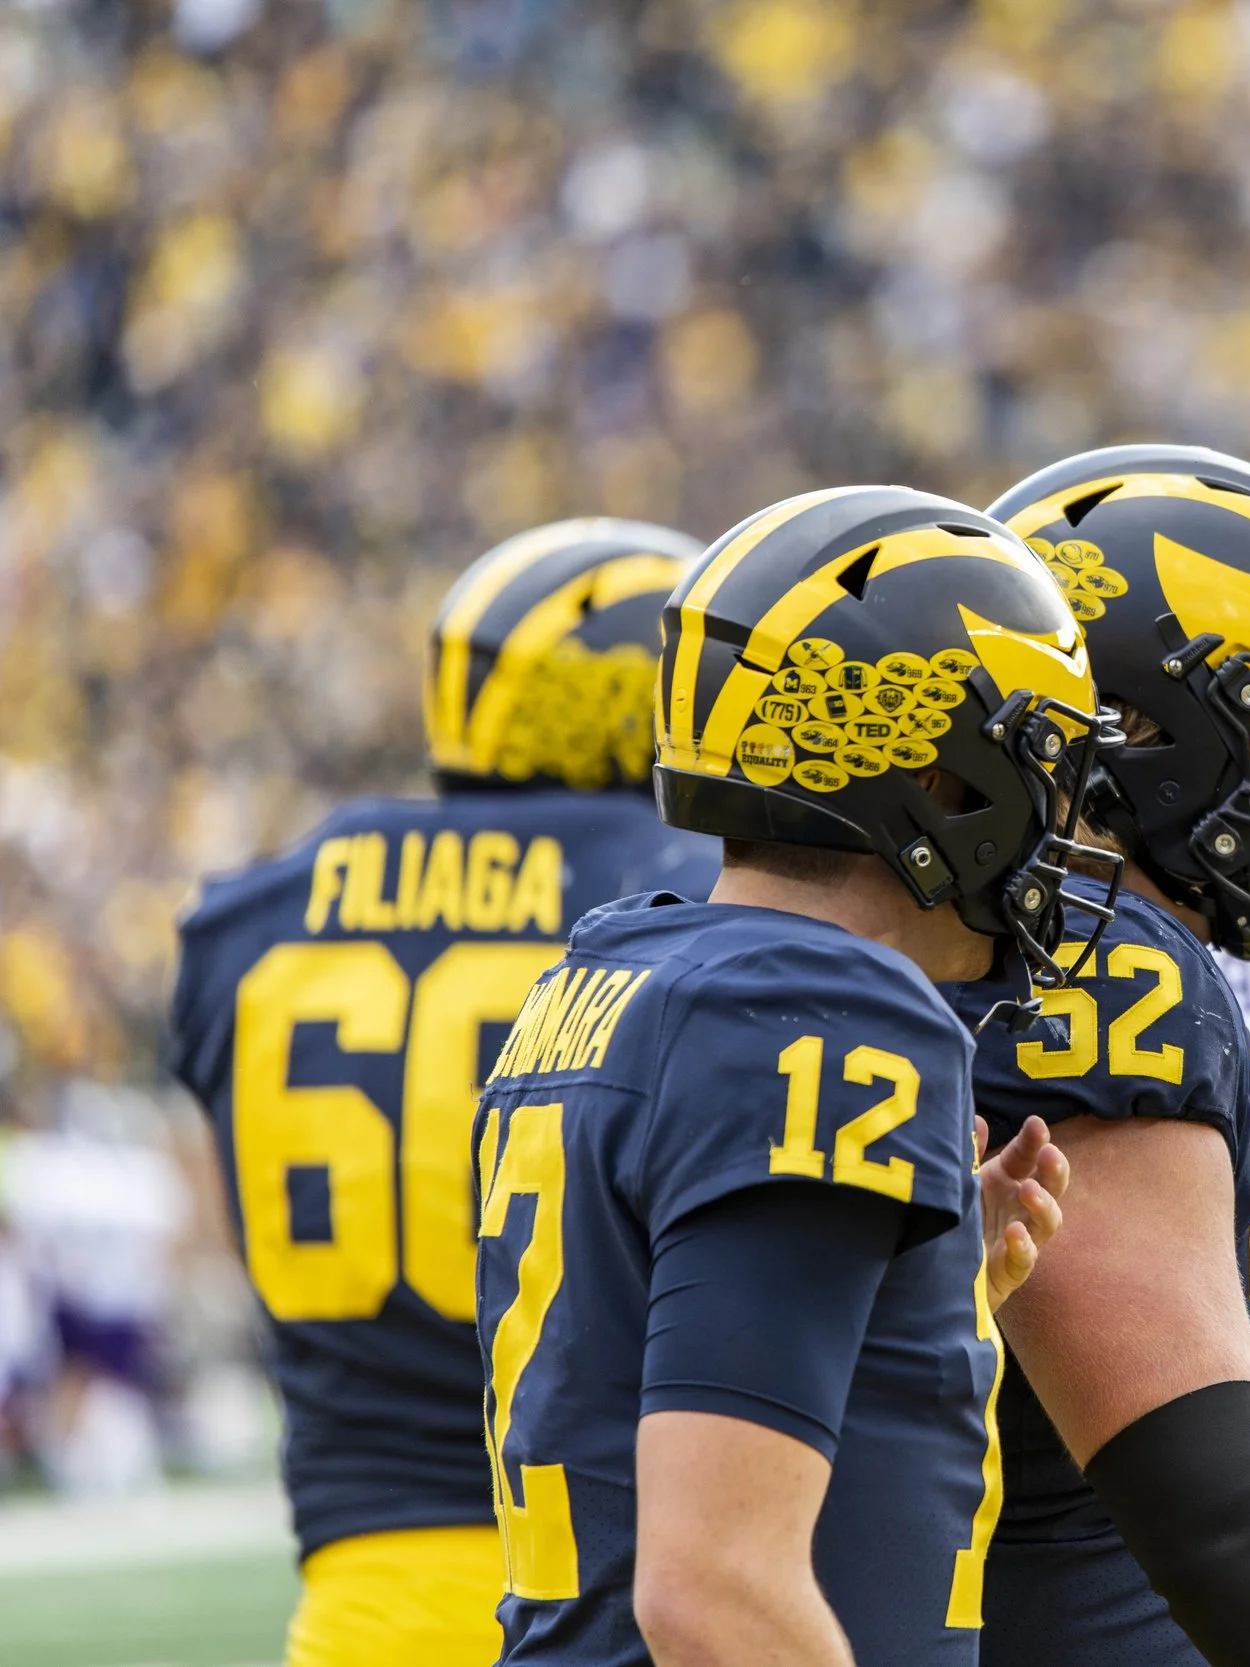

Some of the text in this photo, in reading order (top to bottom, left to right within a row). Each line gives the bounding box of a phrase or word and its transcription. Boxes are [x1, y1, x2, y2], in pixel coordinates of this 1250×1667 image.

[742, 754, 788, 768] EQUALITY
[854, 722, 891, 738] TED
[305, 832, 563, 934] FILIAGA
[1016, 941, 1184, 1085] 52
[769, 1035, 921, 1203] 12
